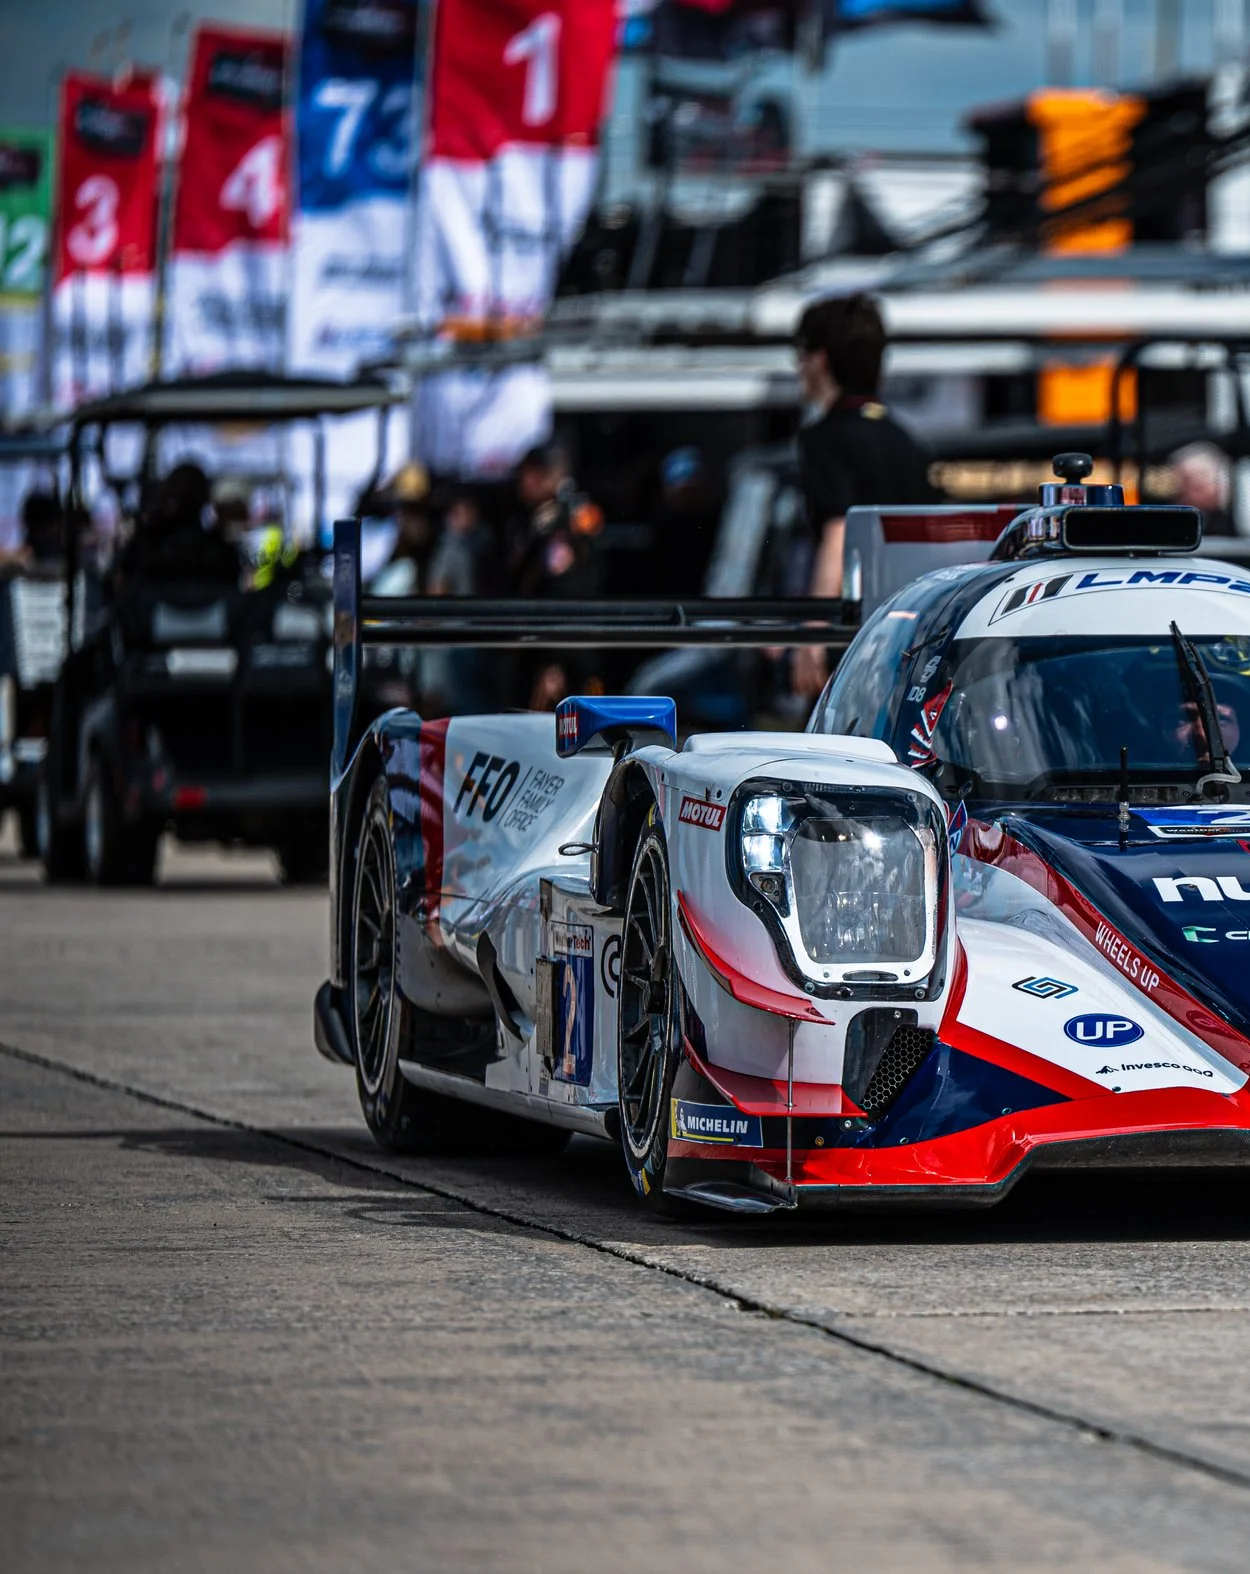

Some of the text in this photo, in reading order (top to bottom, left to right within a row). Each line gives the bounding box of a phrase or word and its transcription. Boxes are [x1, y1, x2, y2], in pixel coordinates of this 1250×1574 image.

[503, 10, 562, 127] 1
[312, 78, 418, 178] 73
[219, 136, 284, 229] 4
[67, 174, 120, 265] 3
[559, 716, 578, 736] MOTUL
[453, 751, 521, 823] FFO
[529, 769, 565, 797] FAYER
[517, 789, 555, 814] FAMILY
[681, 801, 722, 828] MOTUL
[1094, 921, 1160, 992] WHEELS UP
[1076, 1021, 1133, 1040] UP
[1121, 1061, 1214, 1078] Invesco QQQ
[687, 1115, 749, 1134] MICHELIN
